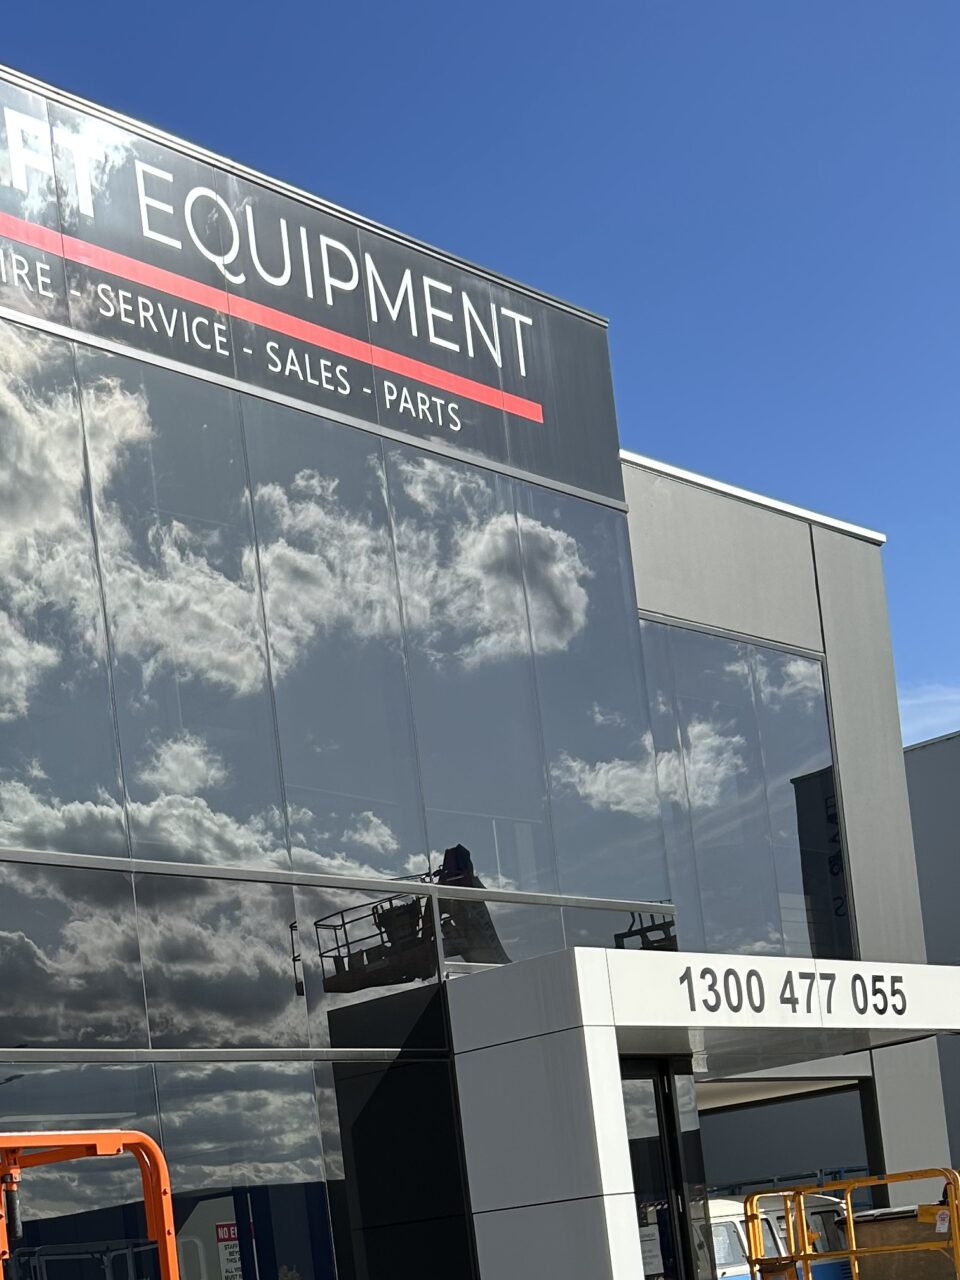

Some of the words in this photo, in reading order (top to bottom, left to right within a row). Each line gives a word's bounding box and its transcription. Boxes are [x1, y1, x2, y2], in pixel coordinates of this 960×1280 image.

[135, 159, 532, 377] EQUIPMENT
[97, 283, 230, 357] SERVICE
[266, 341, 351, 396] SALES
[384, 380, 462, 432] PARTS
[679, 966, 765, 1014] 1300
[779, 970, 837, 1014] 477
[851, 973, 907, 1016] 055
[218, 1226, 229, 1239] NO
